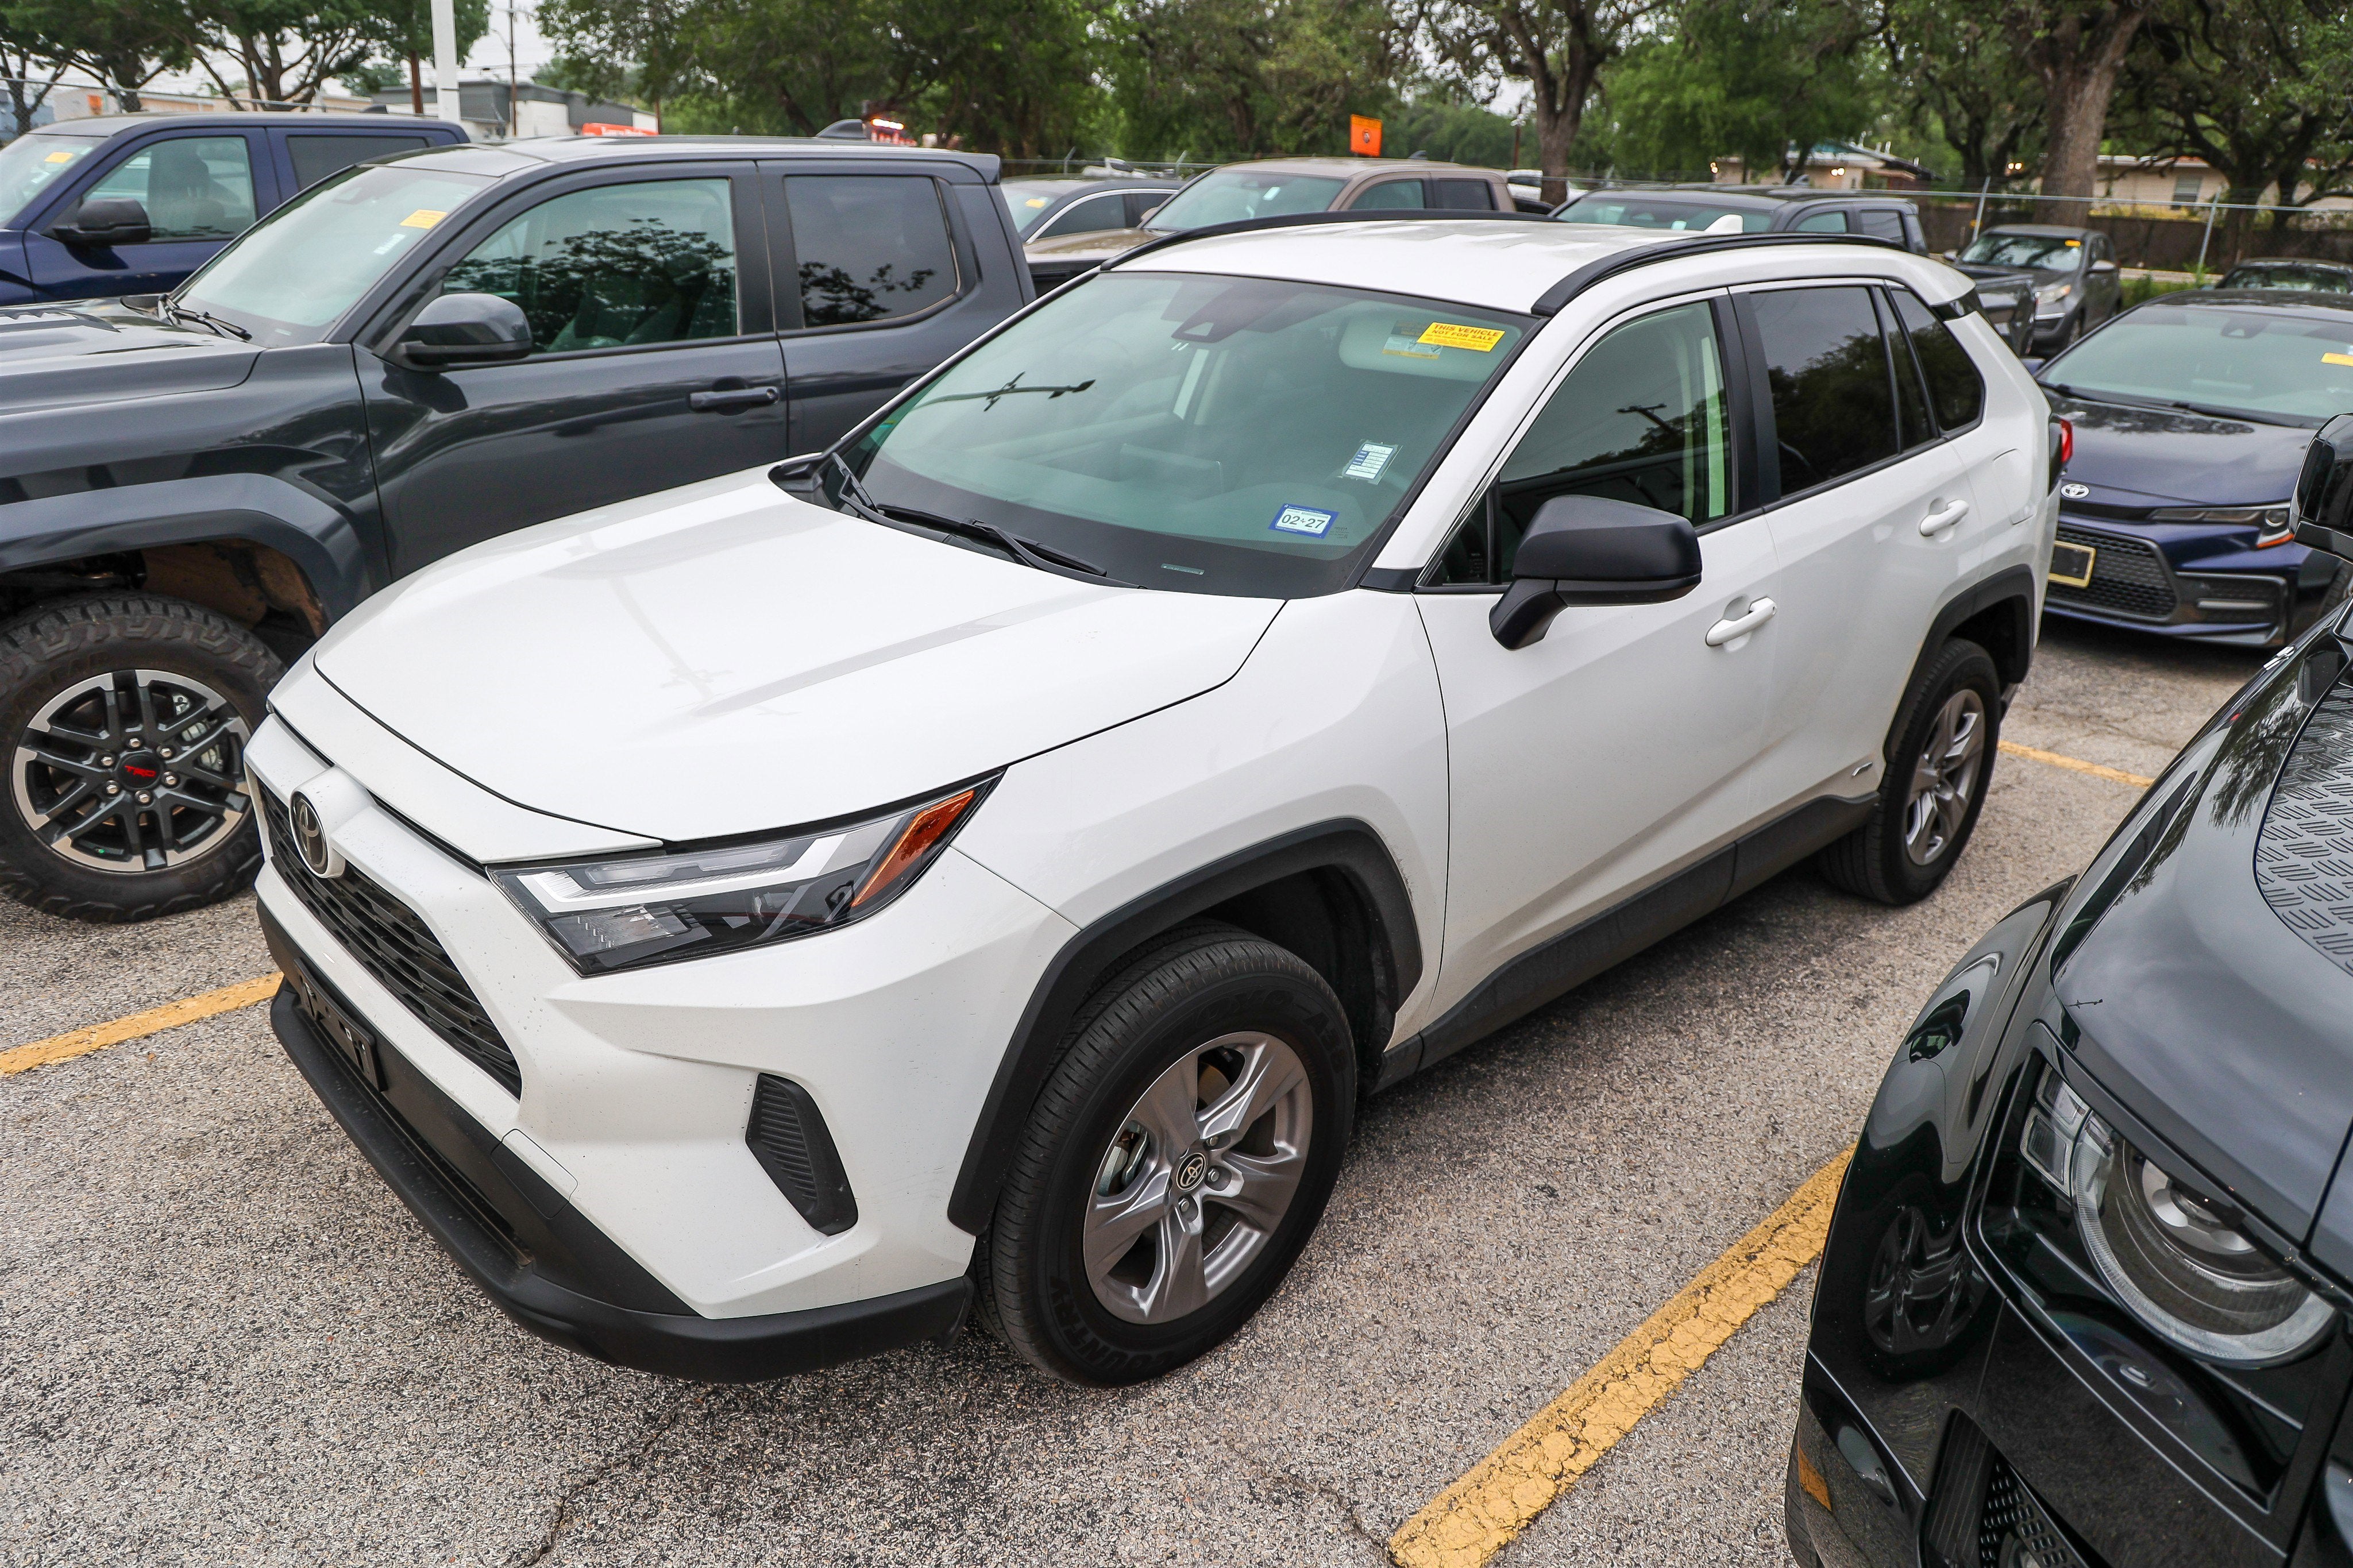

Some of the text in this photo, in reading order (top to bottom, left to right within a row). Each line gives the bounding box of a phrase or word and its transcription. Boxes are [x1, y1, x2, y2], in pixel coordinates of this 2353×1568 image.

[1458, 327, 1500, 337] VEHICLE
[1281, 514, 1301, 526] 02
[1304, 518, 1326, 528] 27
[124, 765, 156, 777] TRD
